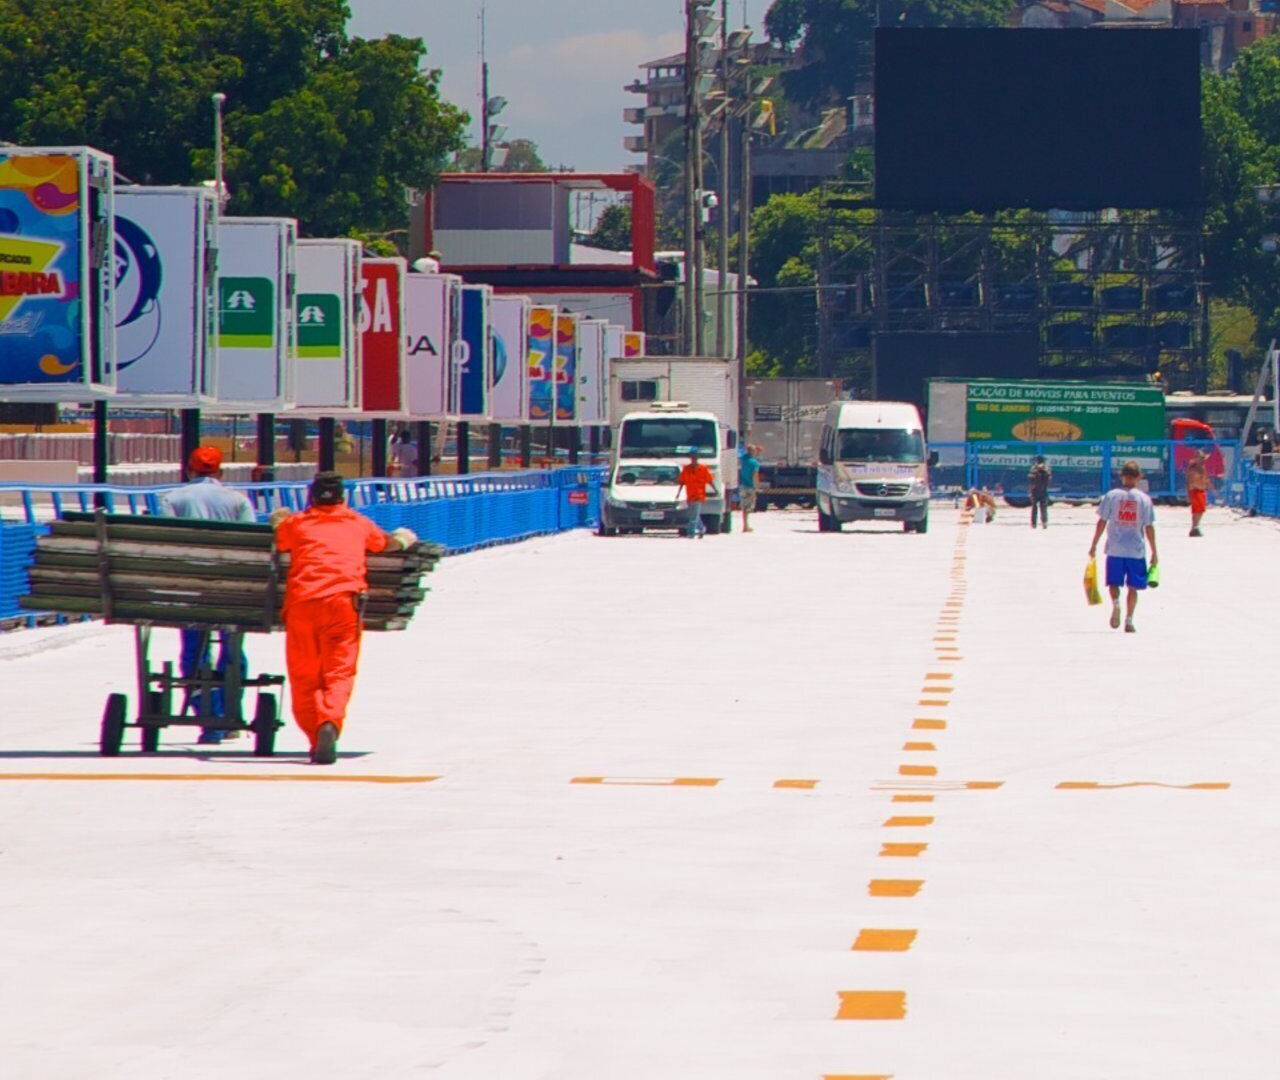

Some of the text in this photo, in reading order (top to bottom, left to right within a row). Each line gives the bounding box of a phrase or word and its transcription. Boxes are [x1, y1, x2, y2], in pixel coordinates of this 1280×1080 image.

[1009, 388, 1022, 398] DE
[1064, 389, 1089, 399] PARA
[1091, 390, 1136, 401] EVENTOS
